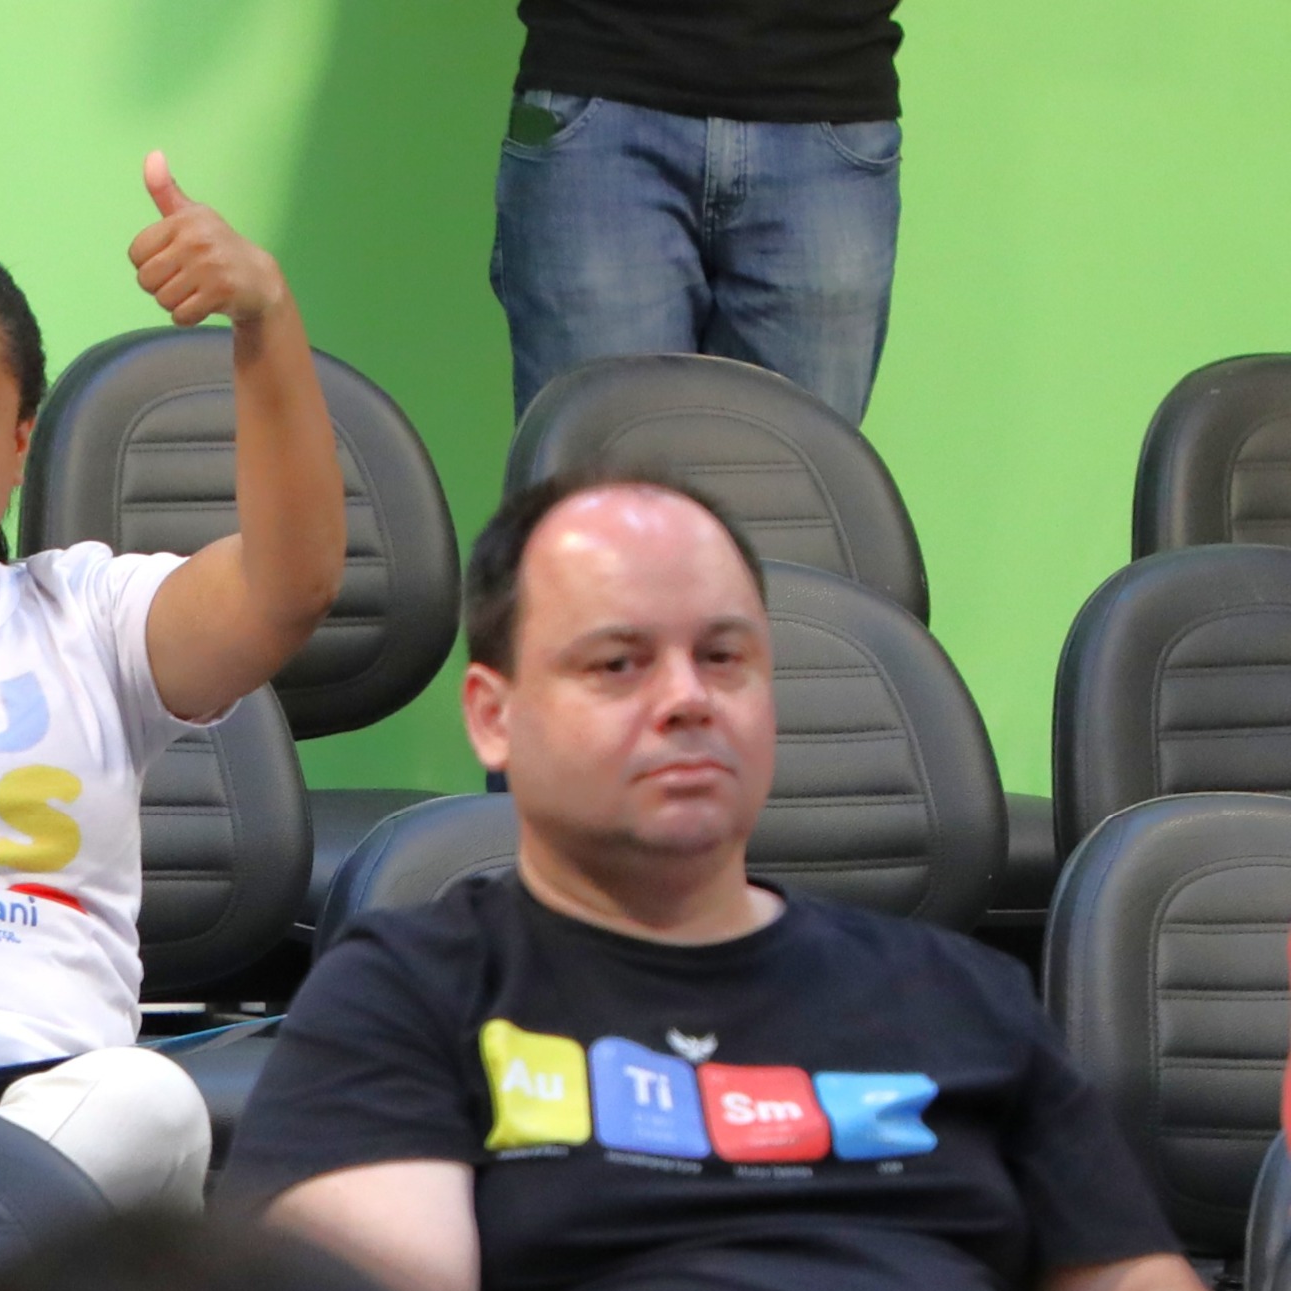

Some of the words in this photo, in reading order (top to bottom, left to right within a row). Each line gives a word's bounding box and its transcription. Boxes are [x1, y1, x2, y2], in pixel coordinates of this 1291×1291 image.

[501, 1056, 564, 1100] Au
[623, 1064, 674, 1112] Ti
[720, 1092, 804, 1126] Sm
